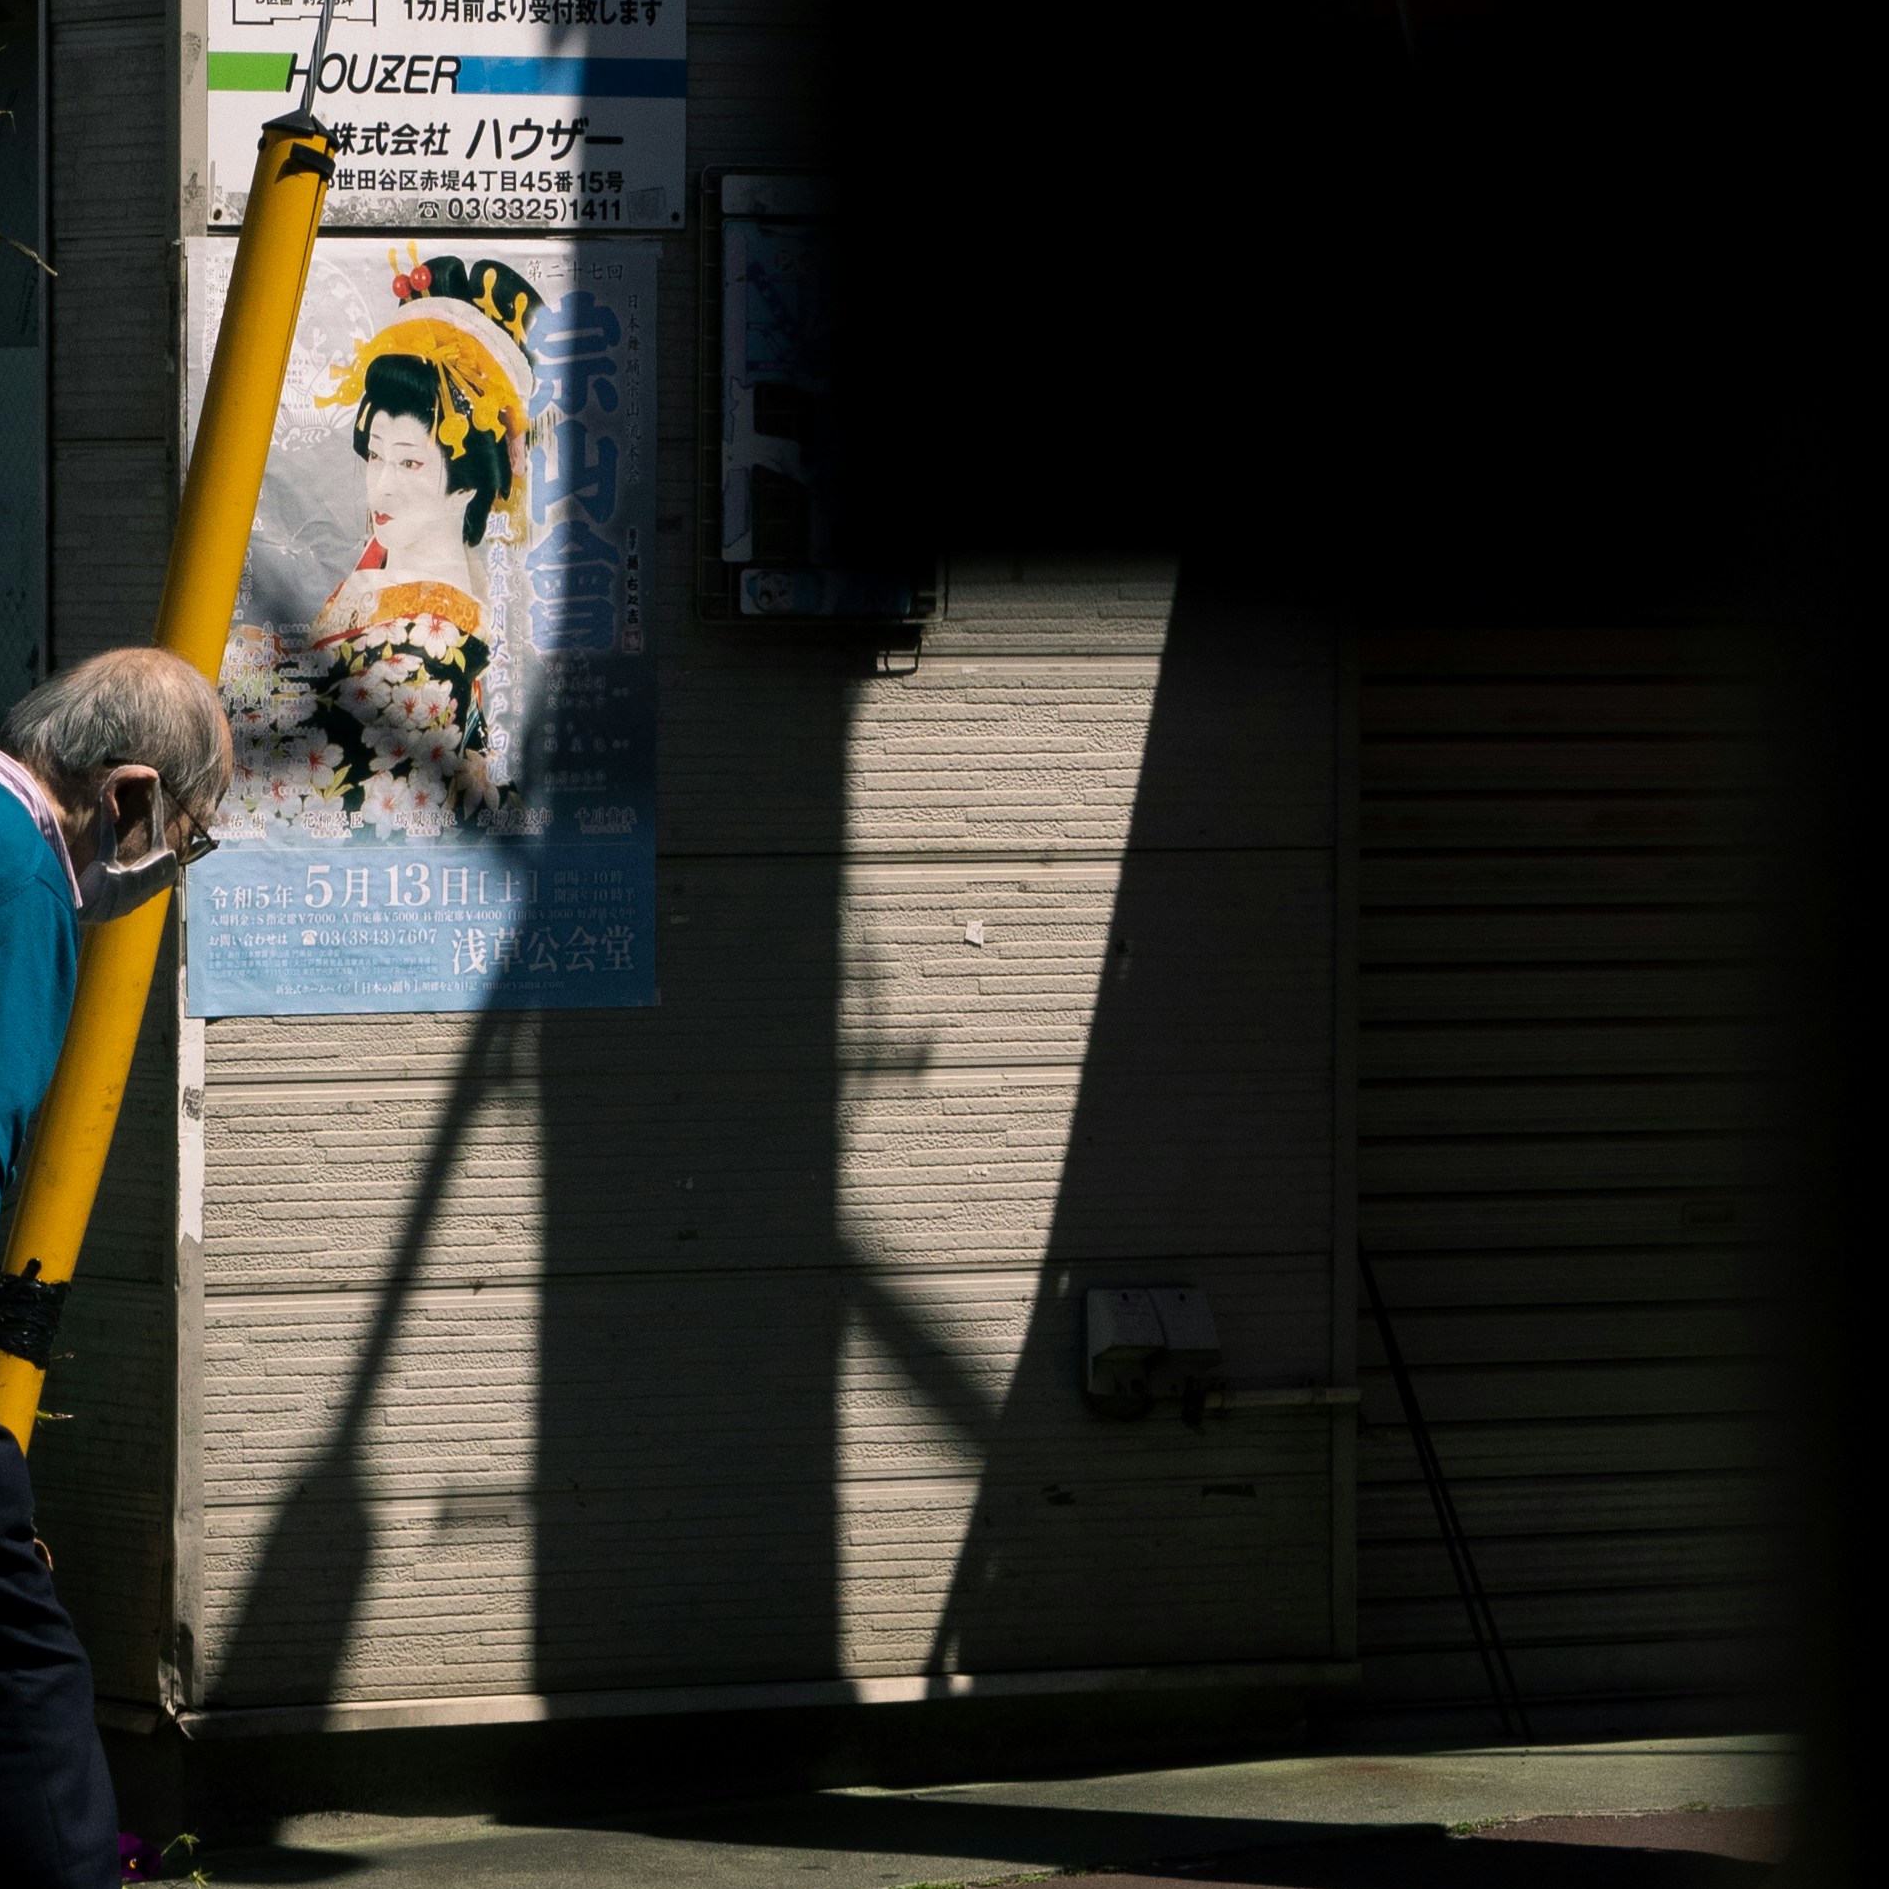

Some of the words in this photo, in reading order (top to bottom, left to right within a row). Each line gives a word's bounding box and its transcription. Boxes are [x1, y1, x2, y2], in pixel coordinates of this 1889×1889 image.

[285, 53, 462, 94] HOUZER
[329, 120, 451, 157] 株式会社
[465, 117, 624, 162] ハウザー
[447, 196, 623, 222] 03(3325)1411
[210, 884, 294, 910] 令和5年
[319, 927, 439, 948] 03(3843)7607
[451, 924, 636, 976] 浅草公会堂
